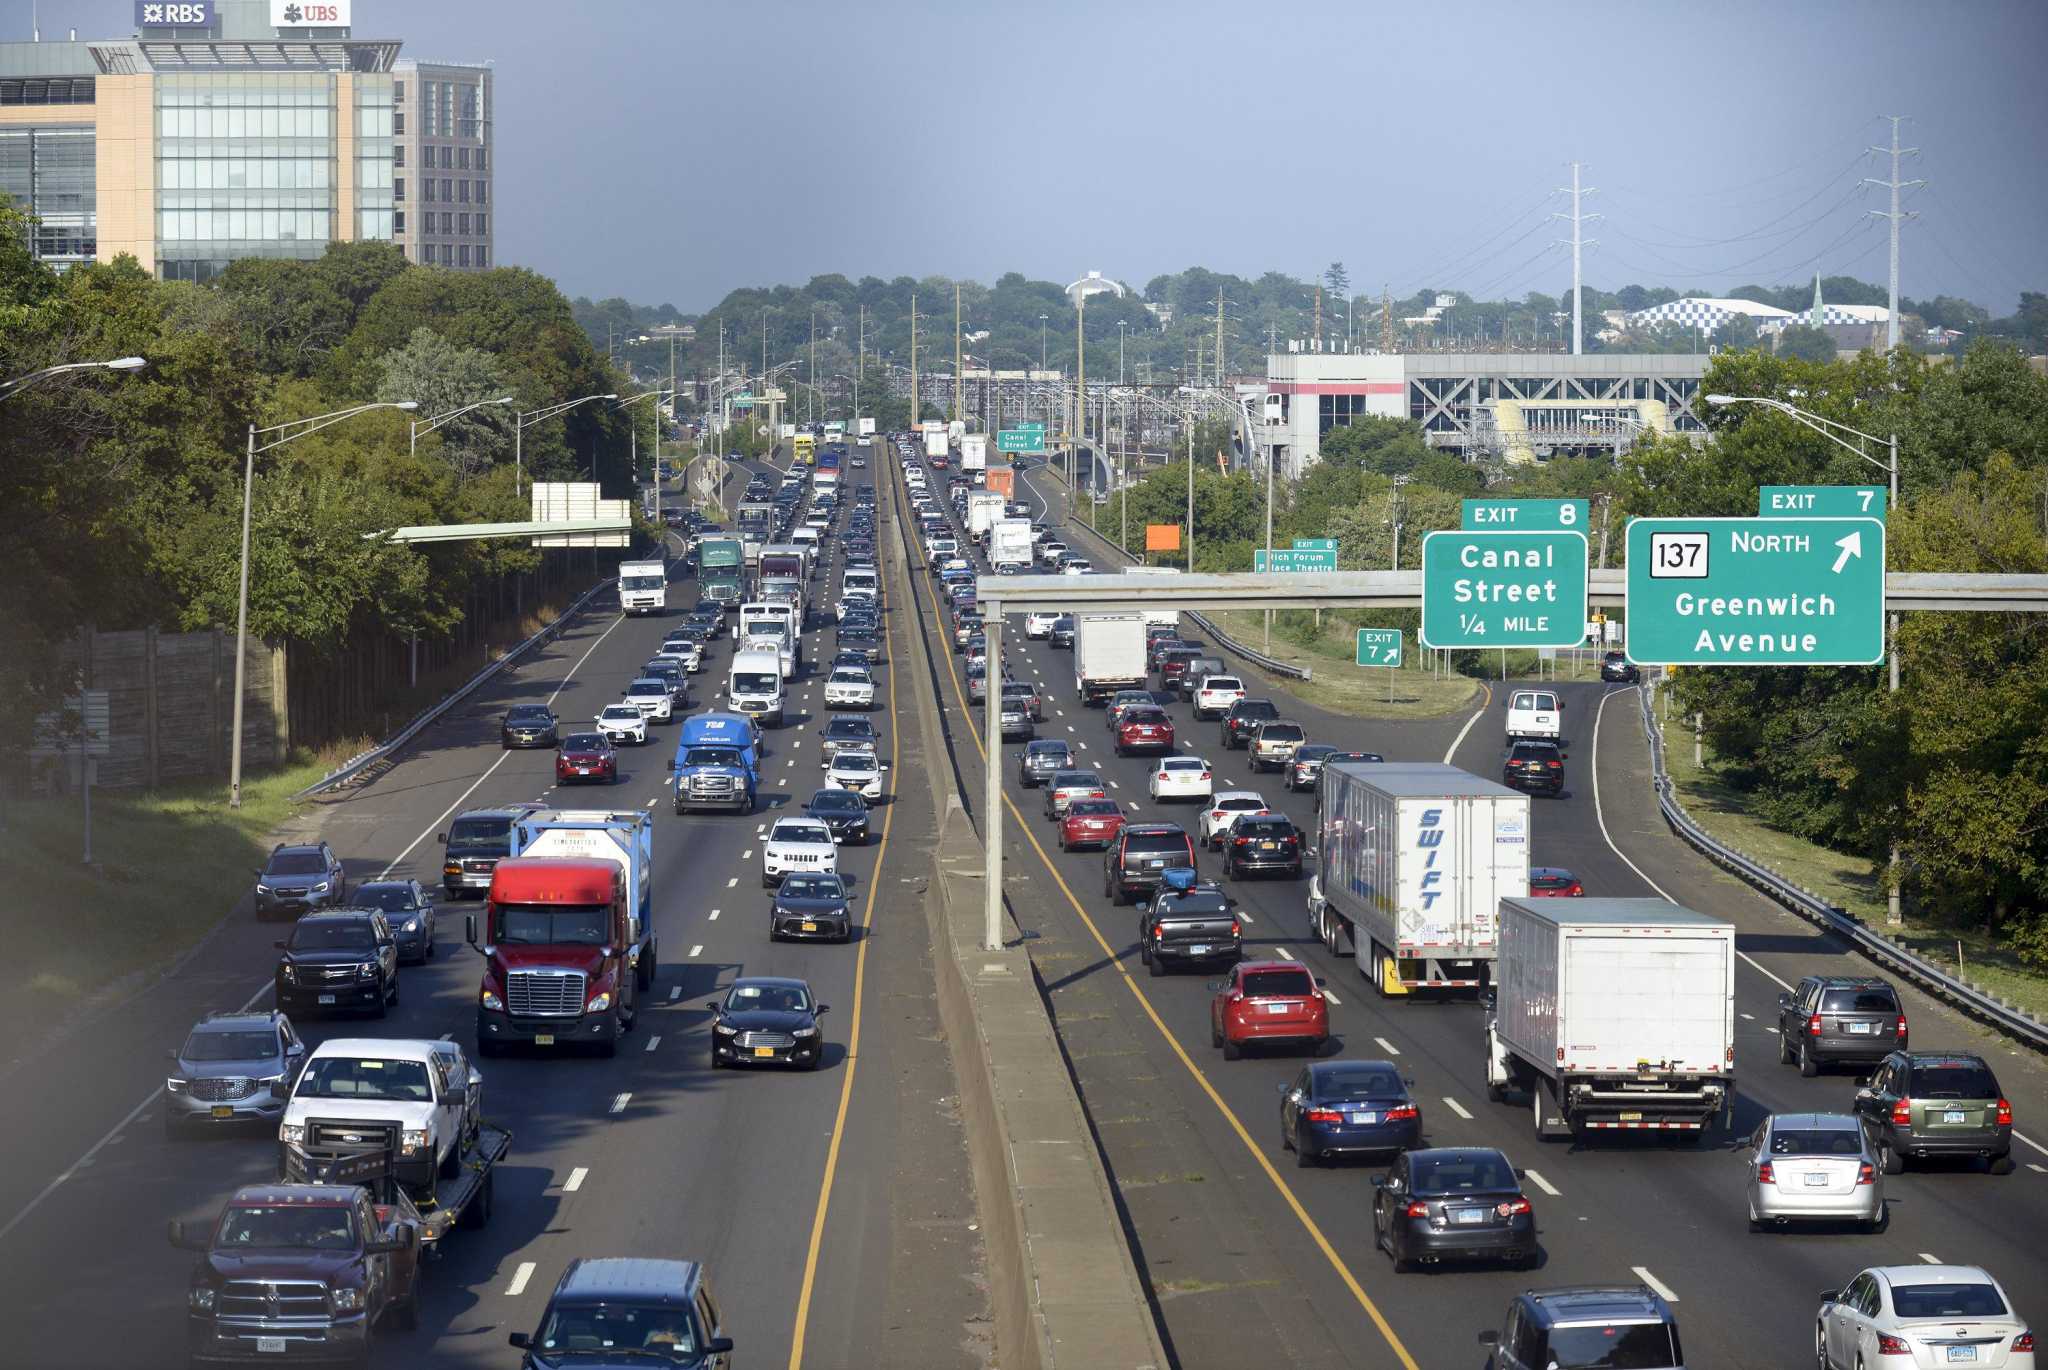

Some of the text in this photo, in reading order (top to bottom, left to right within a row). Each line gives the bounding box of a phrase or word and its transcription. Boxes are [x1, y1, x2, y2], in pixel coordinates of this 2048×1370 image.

[166, 4, 205, 23] RBS
[304, 6, 338, 21] UBS
[1005, 433, 1027, 441] Canal
[1772, 491, 1875, 512] EXIT 7
[1474, 503, 1577, 525] EXIT 8
[1326, 540, 1334, 549] 8
[1731, 531, 1810, 553] NORTH
[1294, 552, 1324, 561] Forum
[1460, 544, 1553, 568] Canal
[1658, 543, 1702, 568] 137
[1296, 563, 1334, 572] Theatre
[1454, 579, 1557, 603] Street
[1675, 593, 1836, 616] Greenwich
[1503, 616, 1549, 632] MILE
[1366, 633, 1393, 643] EXIT
[1694, 629, 1818, 652] Avenue
[1368, 645, 1379, 659] 7
[1417, 809, 1444, 910] SWIFT
